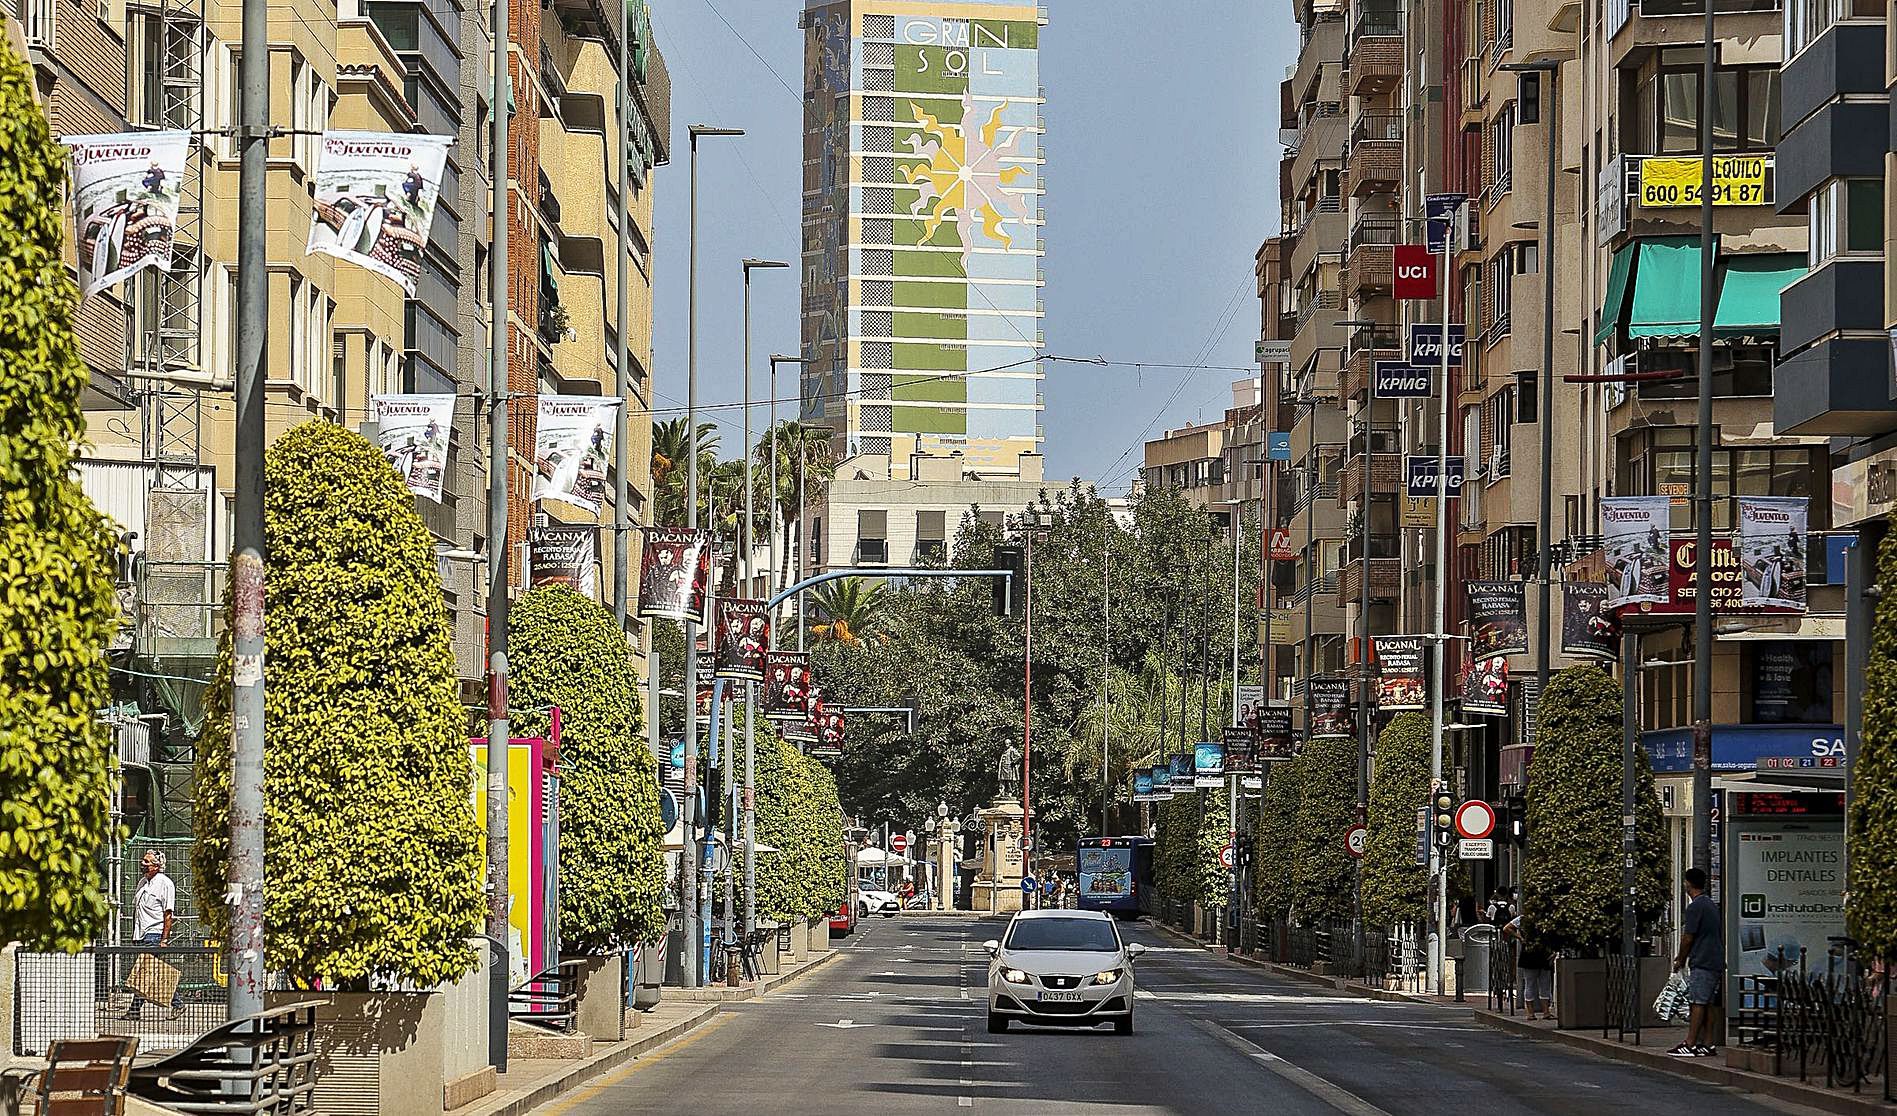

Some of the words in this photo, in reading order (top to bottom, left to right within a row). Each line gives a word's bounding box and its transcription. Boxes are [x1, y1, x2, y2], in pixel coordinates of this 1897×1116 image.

[903, 20, 1009, 49] GRAN
[917, 49, 1004, 76] SOL
[341, 144, 412, 156] JUVENTUD
[80, 147, 151, 166] JUVENTUD
[1712, 160, 1762, 180] LQUILO
[1645, 185, 1678, 202] 600
[1711, 185, 1732, 201] 91
[1739, 185, 1762, 201] 87
[1398, 266, 1427, 279] UCI
[1379, 378, 1427, 390] KPMG
[382, 406, 430, 417] JUVENTUD
[1669, 485, 1688, 495] VENDE
[1611, 511, 1650, 522] JUVENTUD
[1750, 511, 1790, 521] JUVENTUD
[1468, 584, 1523, 594] BACANAL
[1375, 640, 1422, 651] BACANAL
[767, 654, 808, 665] BACANAL
[1310, 682, 1348, 691] BACANAL
[1259, 709, 1290, 718] BACANAL
[1224, 729, 1253, 738] BACANAL
[1767, 758, 1777, 768] 01
[1782, 758, 1794, 768] 02
[1801, 758, 1812, 767] 21
[1822, 758, 1834, 767] 22
[1101, 839, 1111, 847] 23
[1761, 851, 1838, 863] IMPLANTES
[1767, 870, 1837, 882] DENTALES
[1744, 898, 1761, 913] id
[1043, 992, 1064, 1001] 0437
[1066, 992, 1082, 1001] GXX
